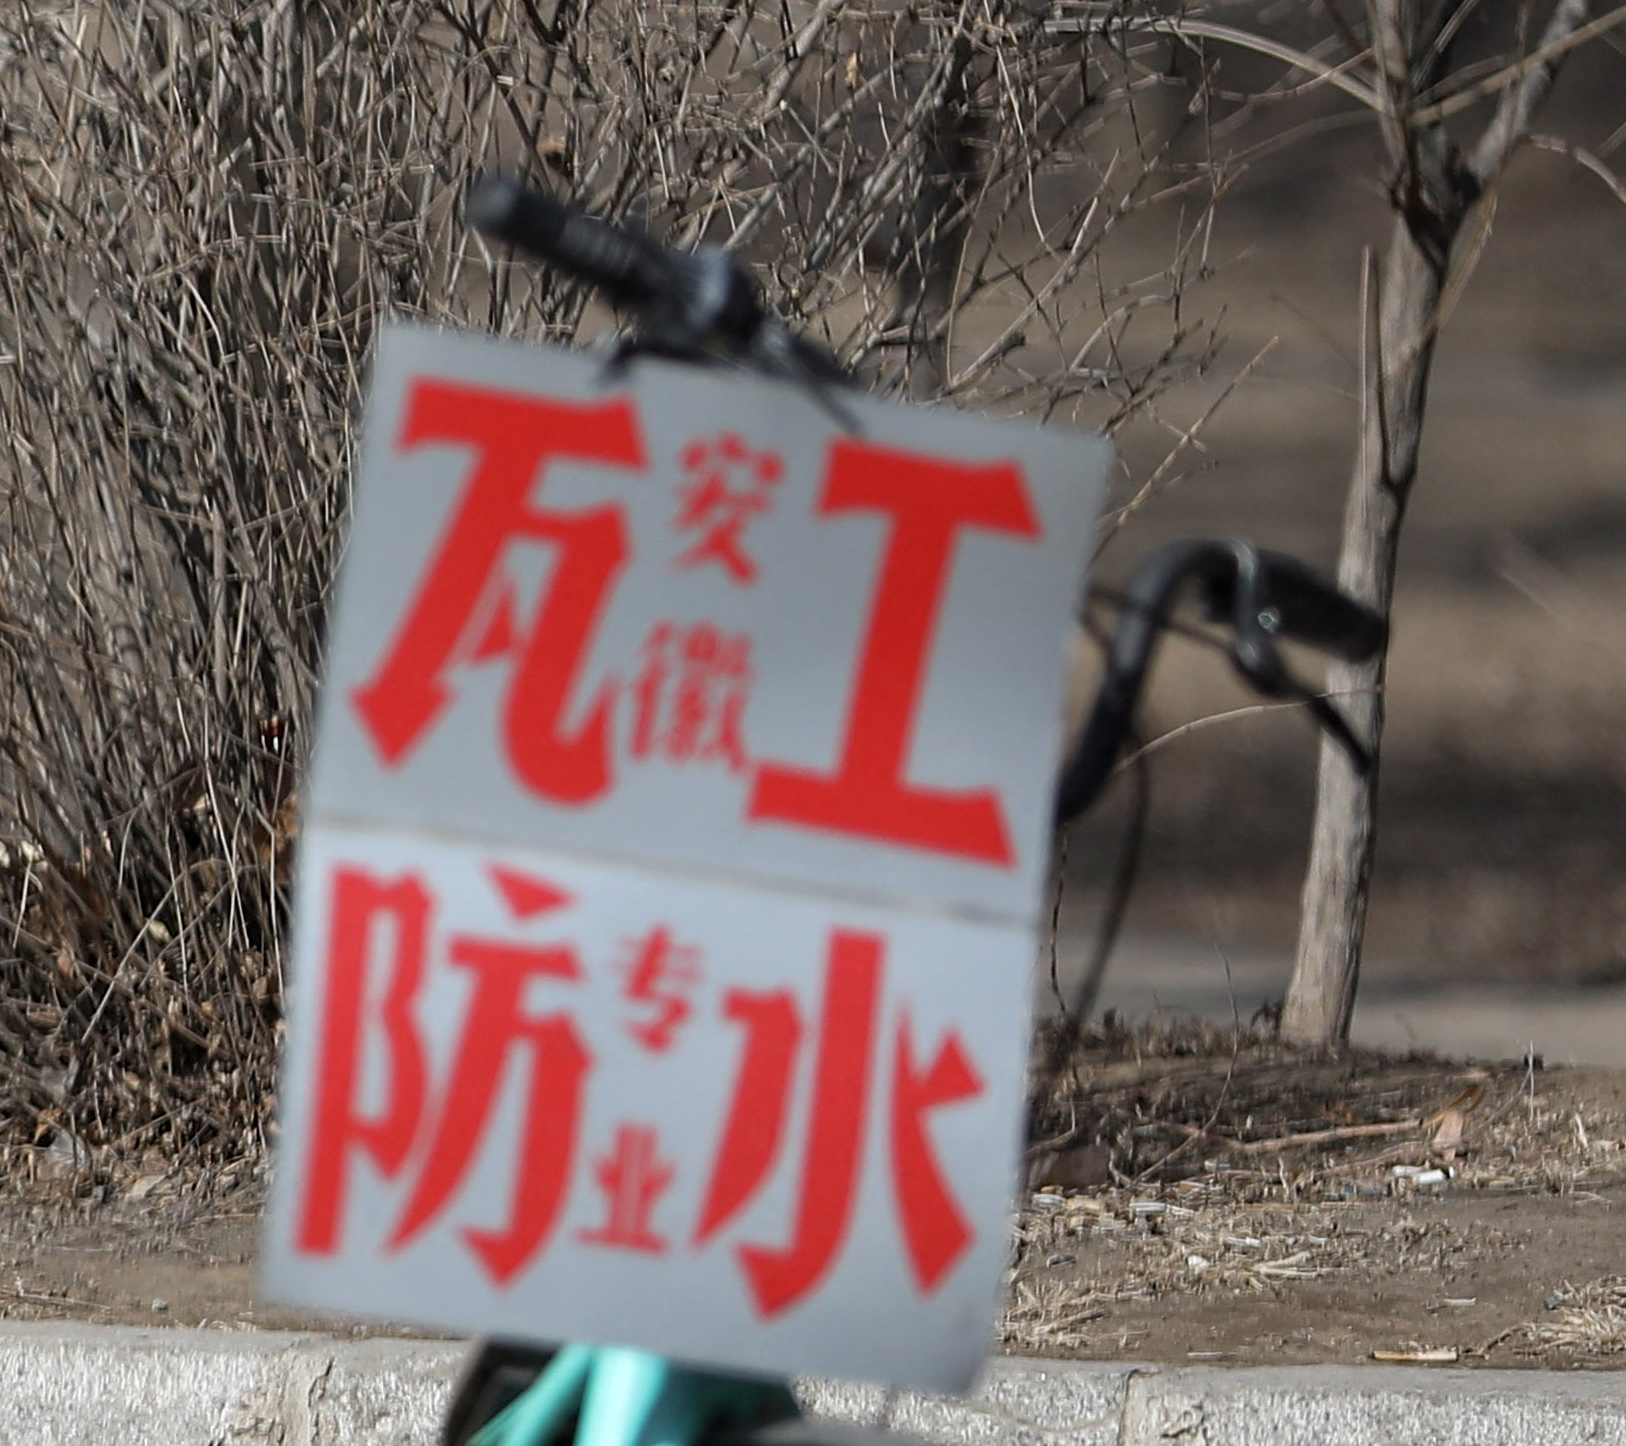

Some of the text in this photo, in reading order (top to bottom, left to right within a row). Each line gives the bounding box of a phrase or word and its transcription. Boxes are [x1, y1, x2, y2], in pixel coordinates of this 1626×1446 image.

[348, 373, 1044, 869] 瓦工
[625, 433, 784, 775] 安徽
[293, 863, 986, 1322] 防水
[577, 923, 704, 1255] 专业
